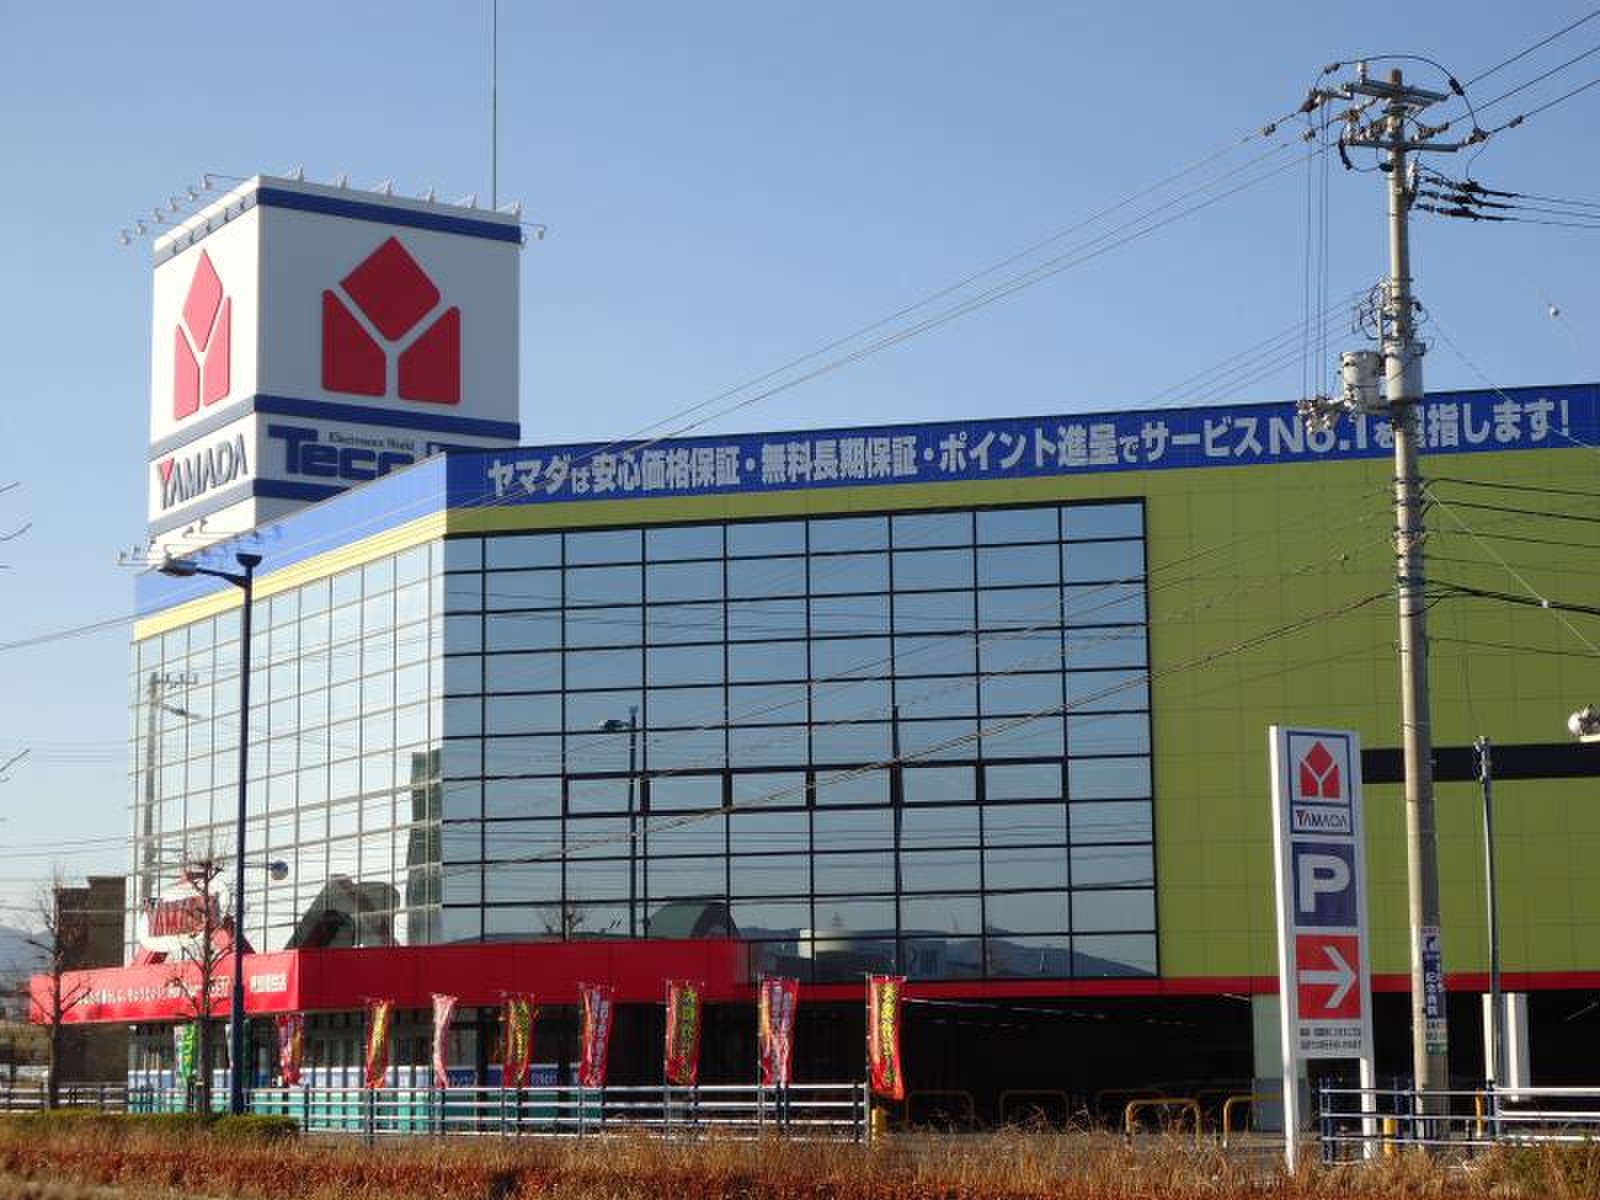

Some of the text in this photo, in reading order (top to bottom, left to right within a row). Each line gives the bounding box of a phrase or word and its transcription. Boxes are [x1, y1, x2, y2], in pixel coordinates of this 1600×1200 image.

[159, 432, 248, 510] YAMADA
[1294, 809, 1347, 828] YAMADA
[1299, 853, 1350, 913] P
